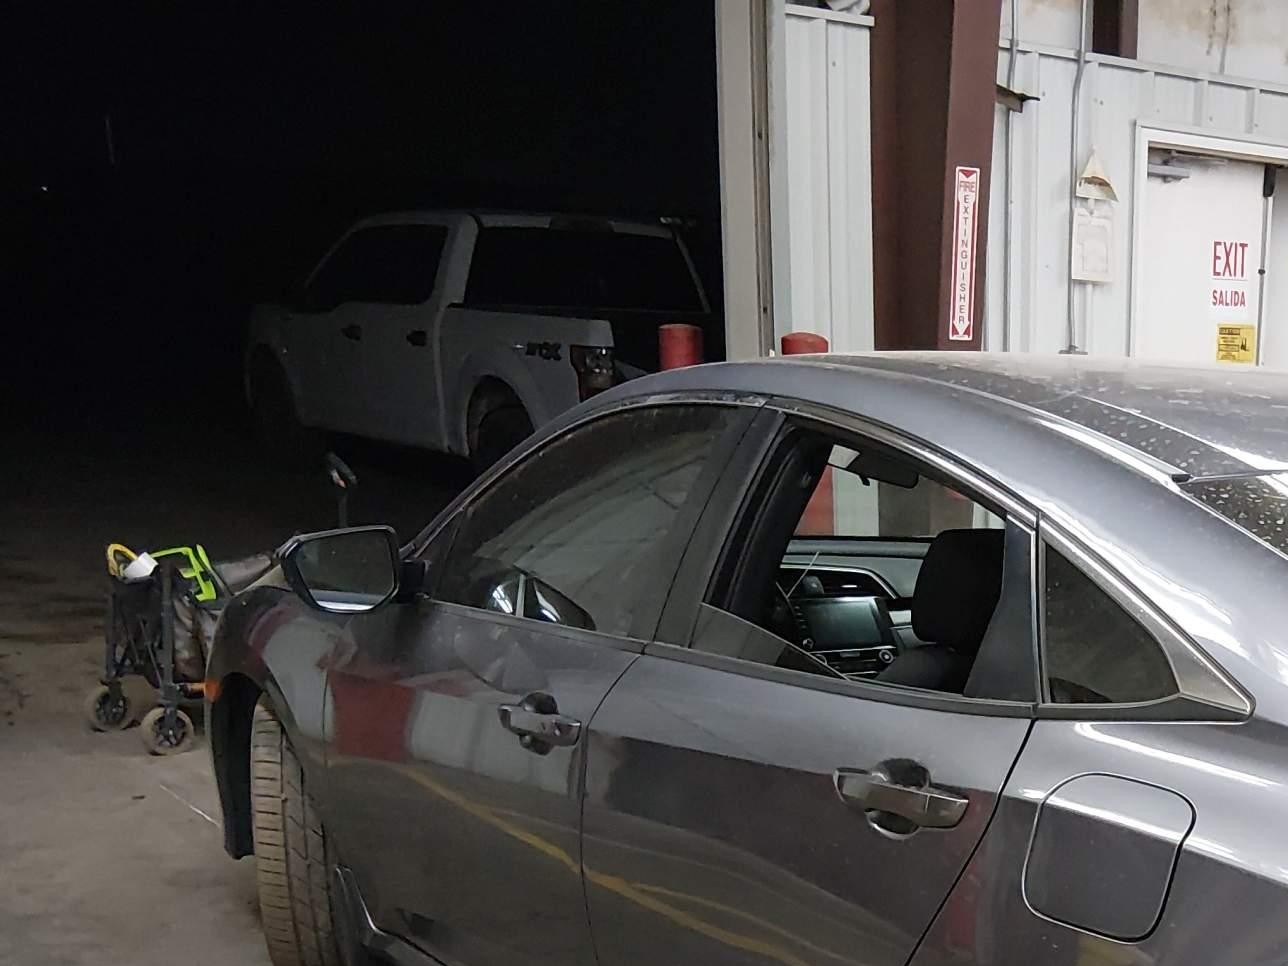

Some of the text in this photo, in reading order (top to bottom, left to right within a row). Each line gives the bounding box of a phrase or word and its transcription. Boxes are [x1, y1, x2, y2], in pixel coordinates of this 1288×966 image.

[959, 181, 976, 192] FIRE
[959, 194, 970, 324] EXTINGUISHER
[1213, 241, 1248, 277] EXIT
[1212, 290, 1246, 307] SALIDA
